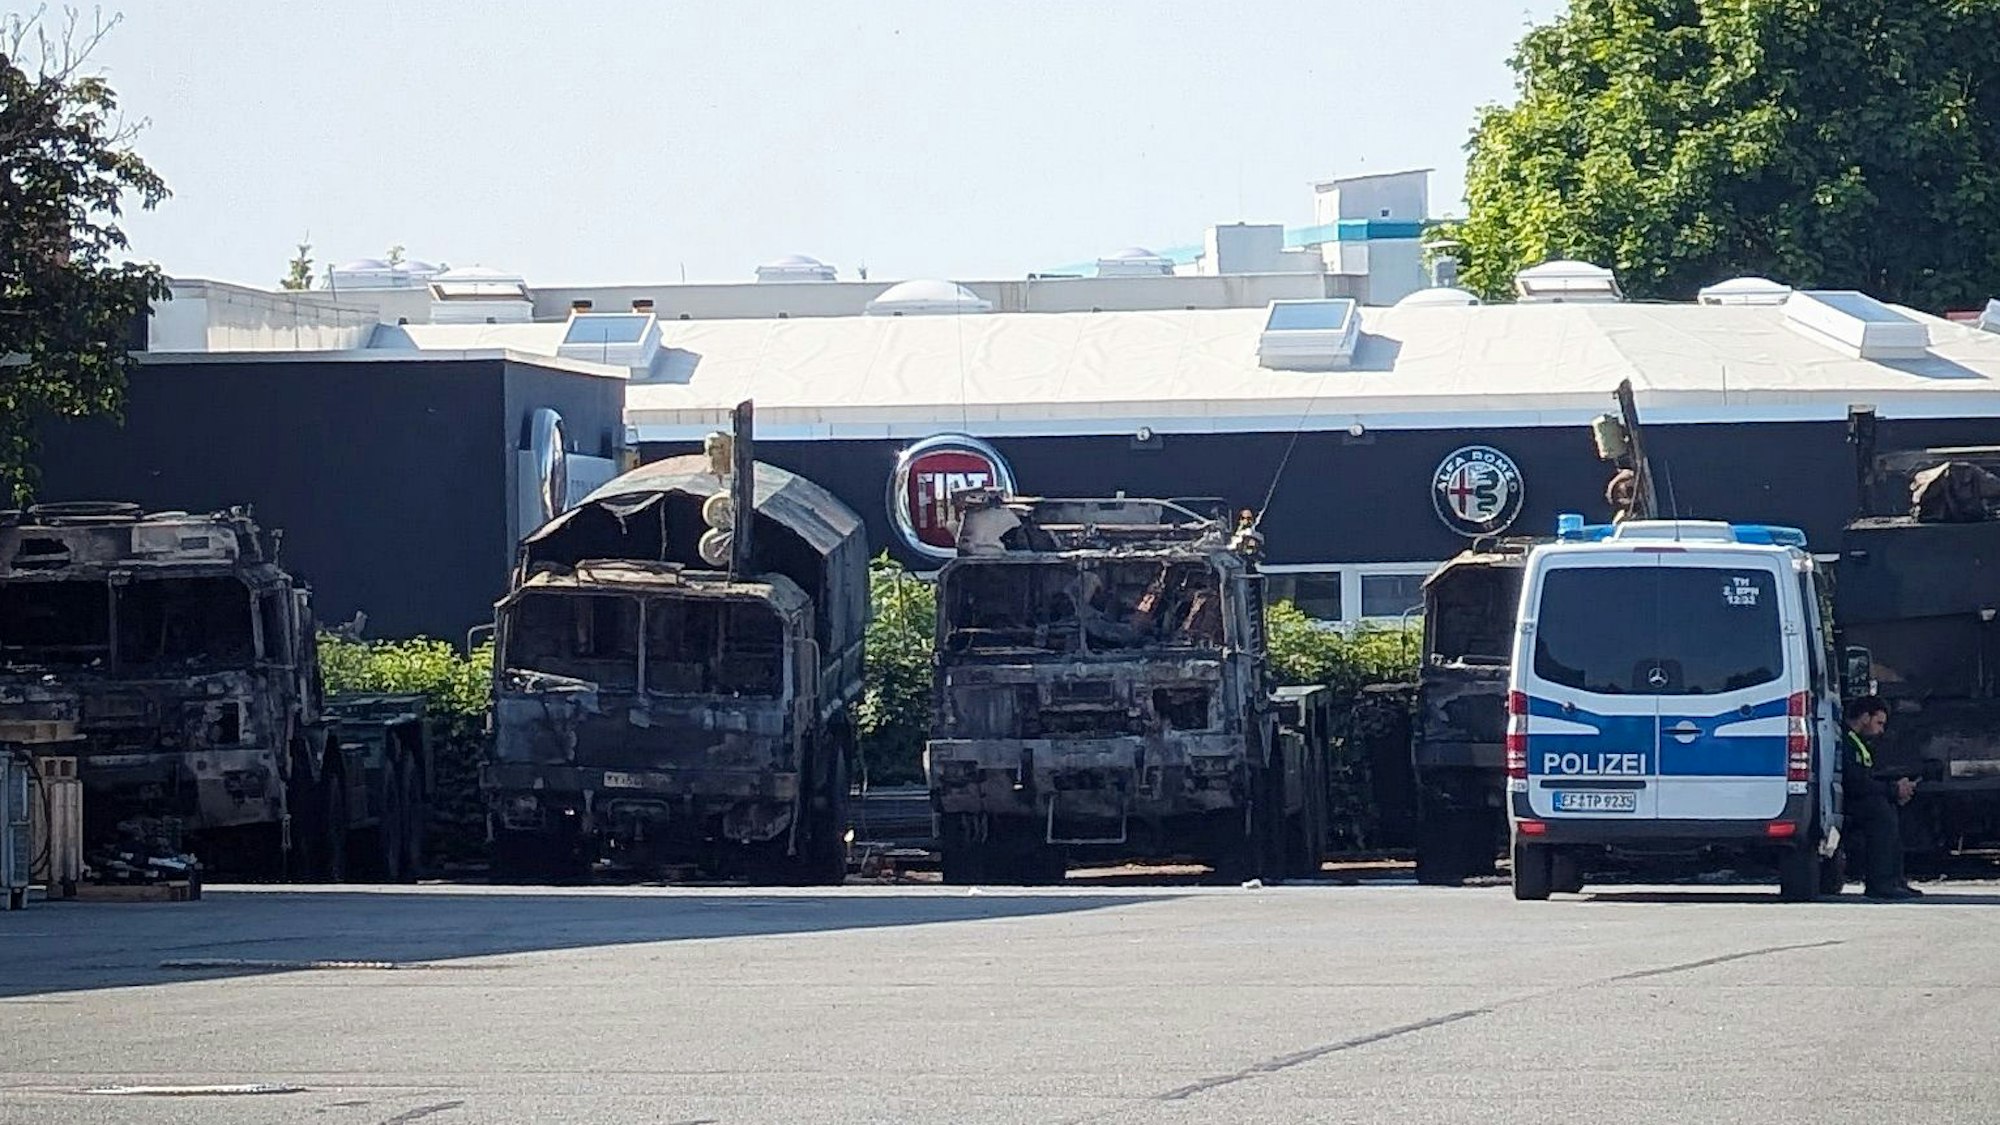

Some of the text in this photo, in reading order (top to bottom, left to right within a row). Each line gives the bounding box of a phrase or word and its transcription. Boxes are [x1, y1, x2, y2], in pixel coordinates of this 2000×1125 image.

[1437, 451, 1518, 493] ALFA ROMEO
[1543, 752, 1646, 775] POLIZEI
[1586, 794, 1601, 808] TP
